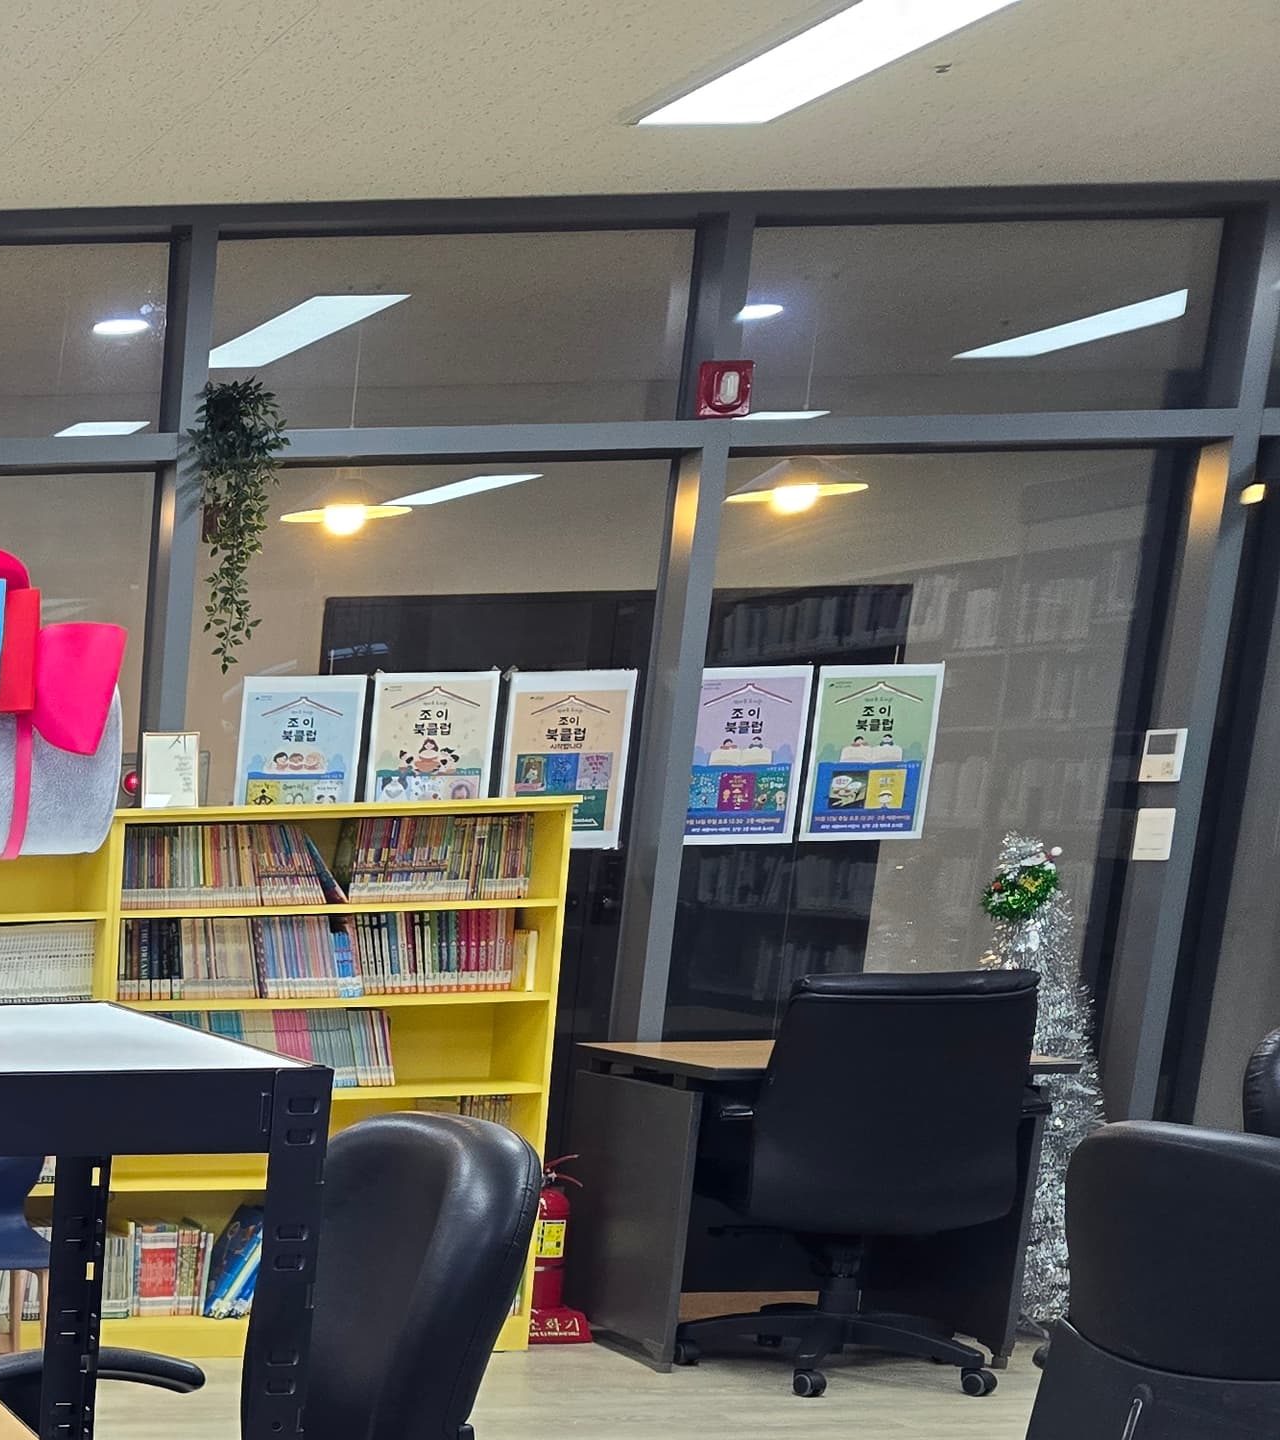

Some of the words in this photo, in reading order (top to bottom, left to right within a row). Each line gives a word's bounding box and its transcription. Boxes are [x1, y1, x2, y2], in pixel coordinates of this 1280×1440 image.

[558, 716, 580, 726] 조이
[724, 721, 763, 734] 북클럽
[856, 718, 895, 732] 북클럽
[281, 729, 317, 742] 북클럽
[413, 722, 452, 736] 북클럽
[545, 727, 587, 742] 북클럽
